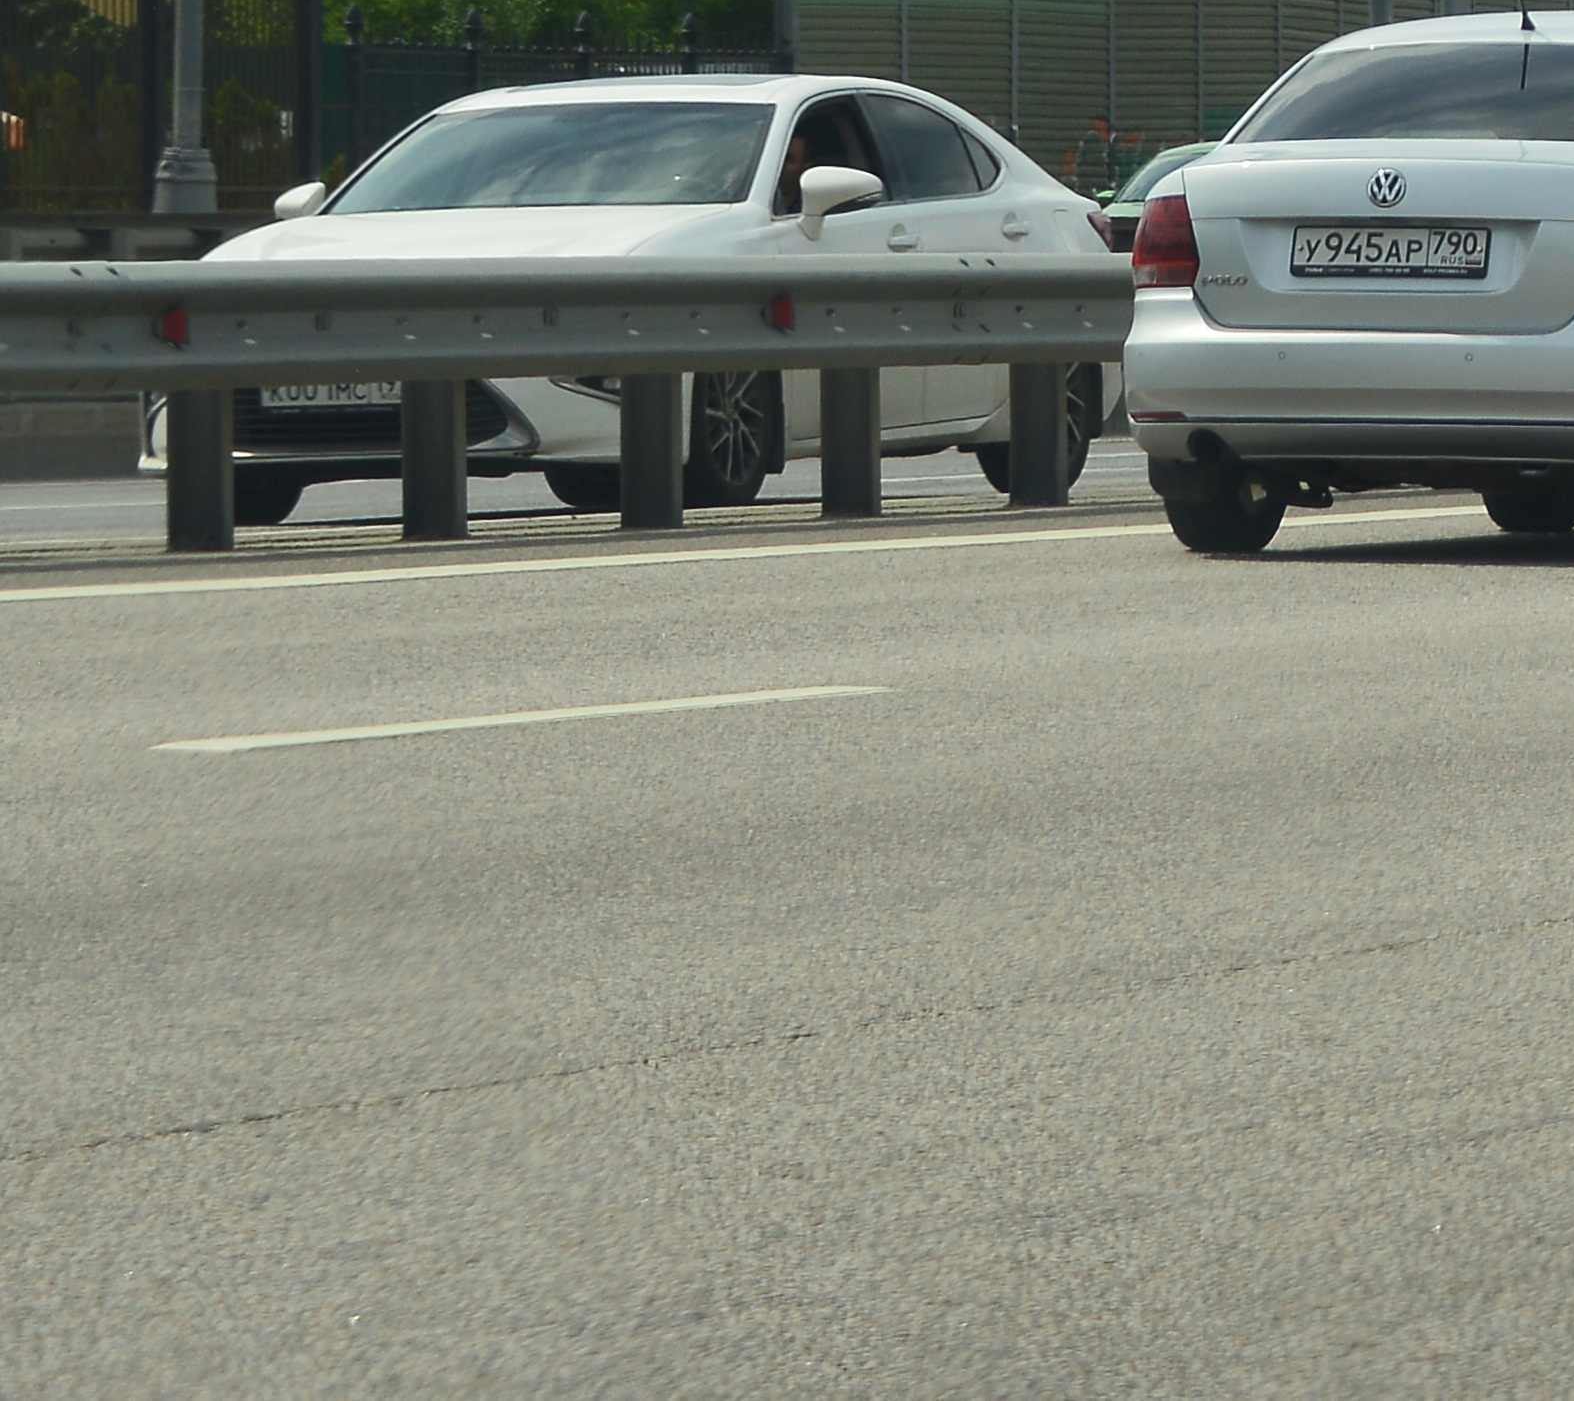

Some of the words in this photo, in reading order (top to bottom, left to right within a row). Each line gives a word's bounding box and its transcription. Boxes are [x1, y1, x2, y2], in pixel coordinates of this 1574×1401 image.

[1304, 232, 1424, 264] У945АР
[1432, 231, 1478, 255] 790
[1440, 256, 1465, 266] RUS
